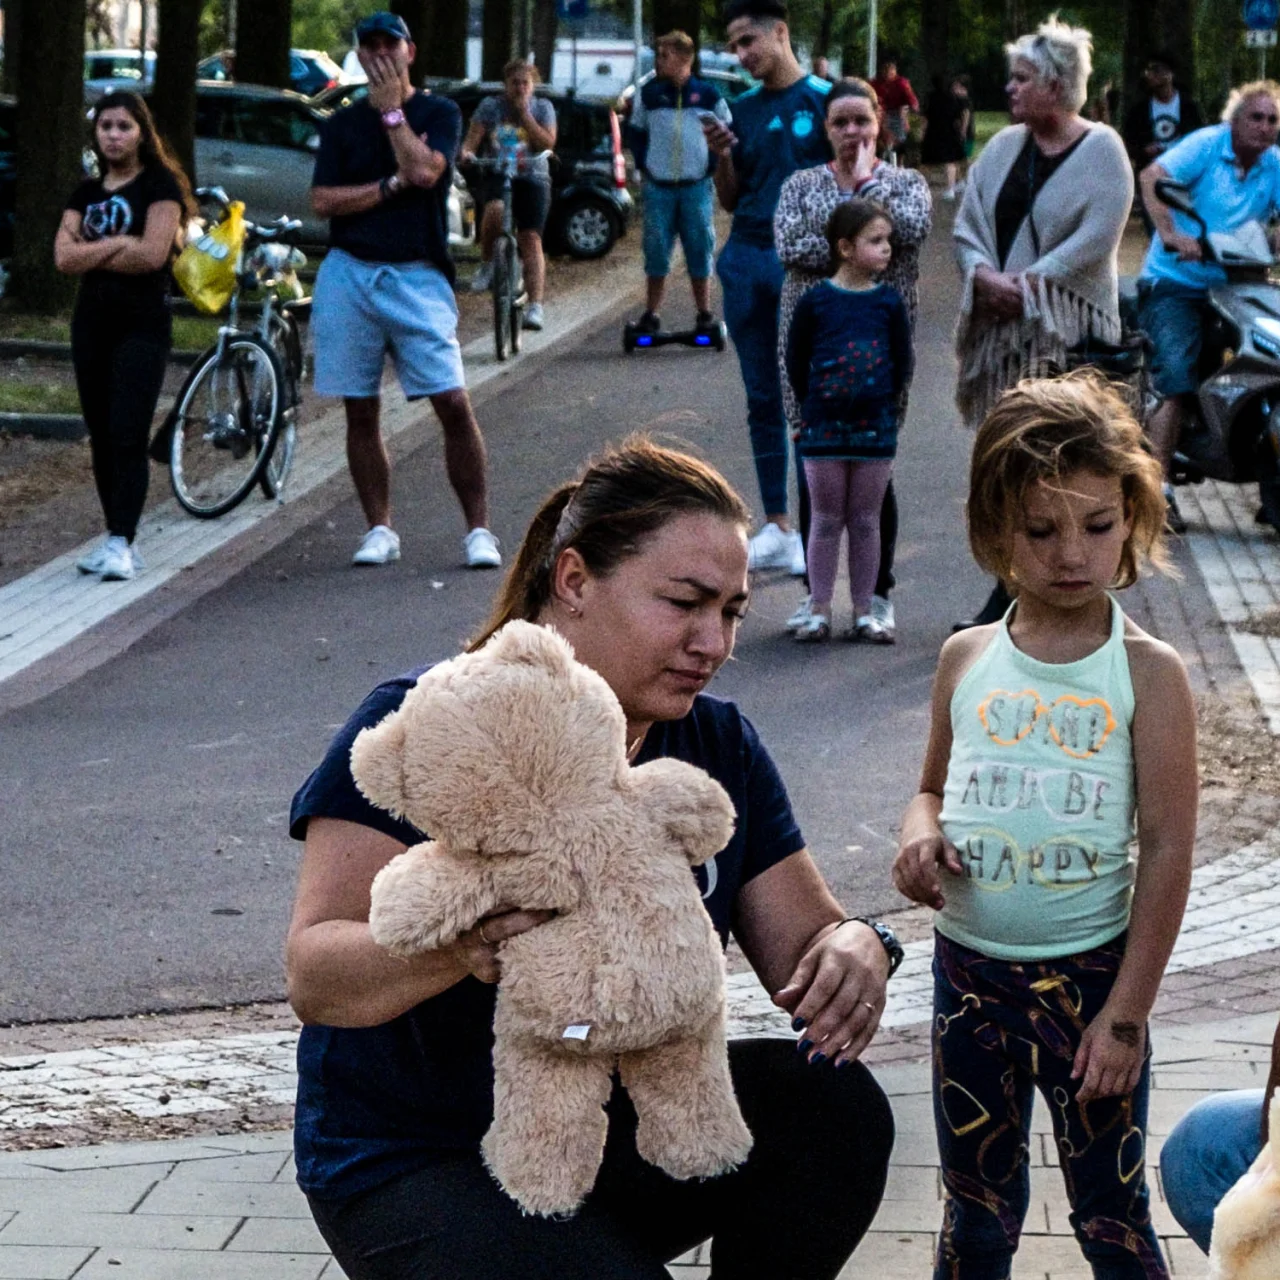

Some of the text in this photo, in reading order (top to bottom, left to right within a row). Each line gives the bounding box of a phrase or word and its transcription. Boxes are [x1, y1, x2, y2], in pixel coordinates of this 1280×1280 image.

[961, 763, 1111, 821] AND BE
[967, 838, 1099, 885] HAPPY
